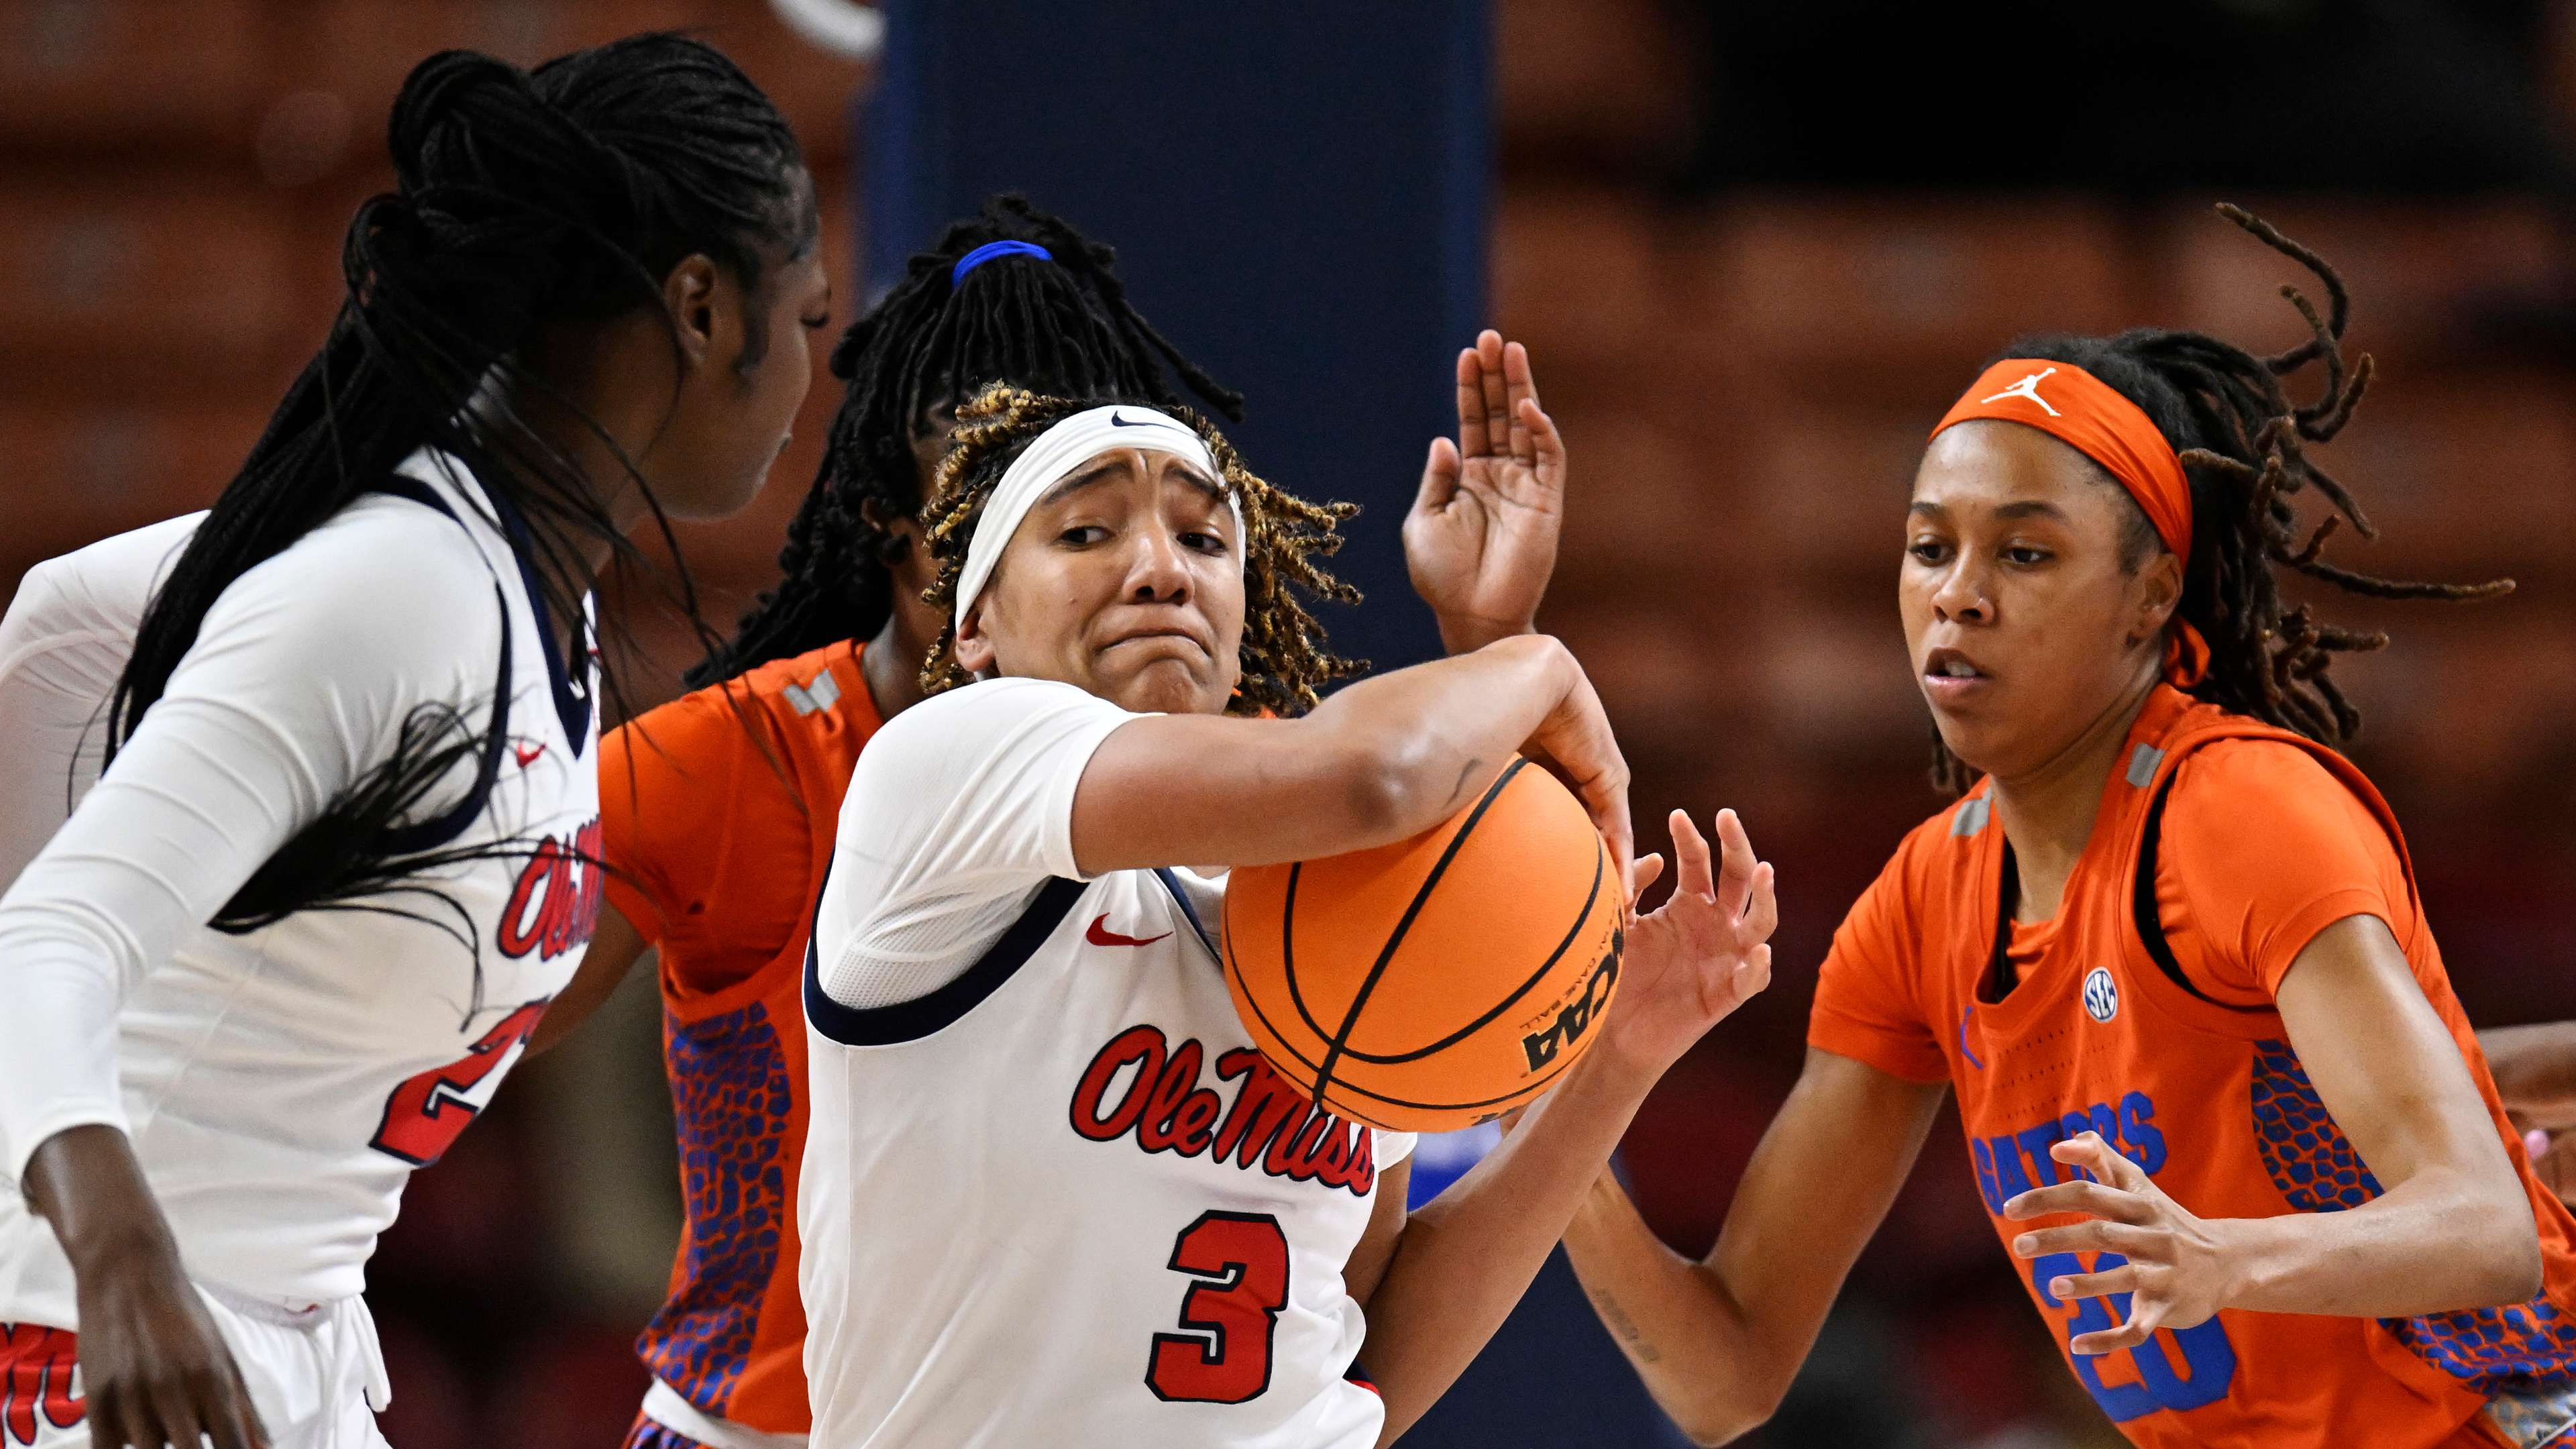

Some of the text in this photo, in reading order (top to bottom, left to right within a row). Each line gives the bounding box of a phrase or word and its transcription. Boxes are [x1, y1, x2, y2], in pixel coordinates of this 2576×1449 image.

[1519, 999, 1562, 1030] BALL
[2085, 971, 2116, 1020] SEC
[1070, 1024, 1375, 1197] Ole Miss
[1144, 1210, 1290, 1405] 3
[2031, 1251, 2237, 1423] 20
